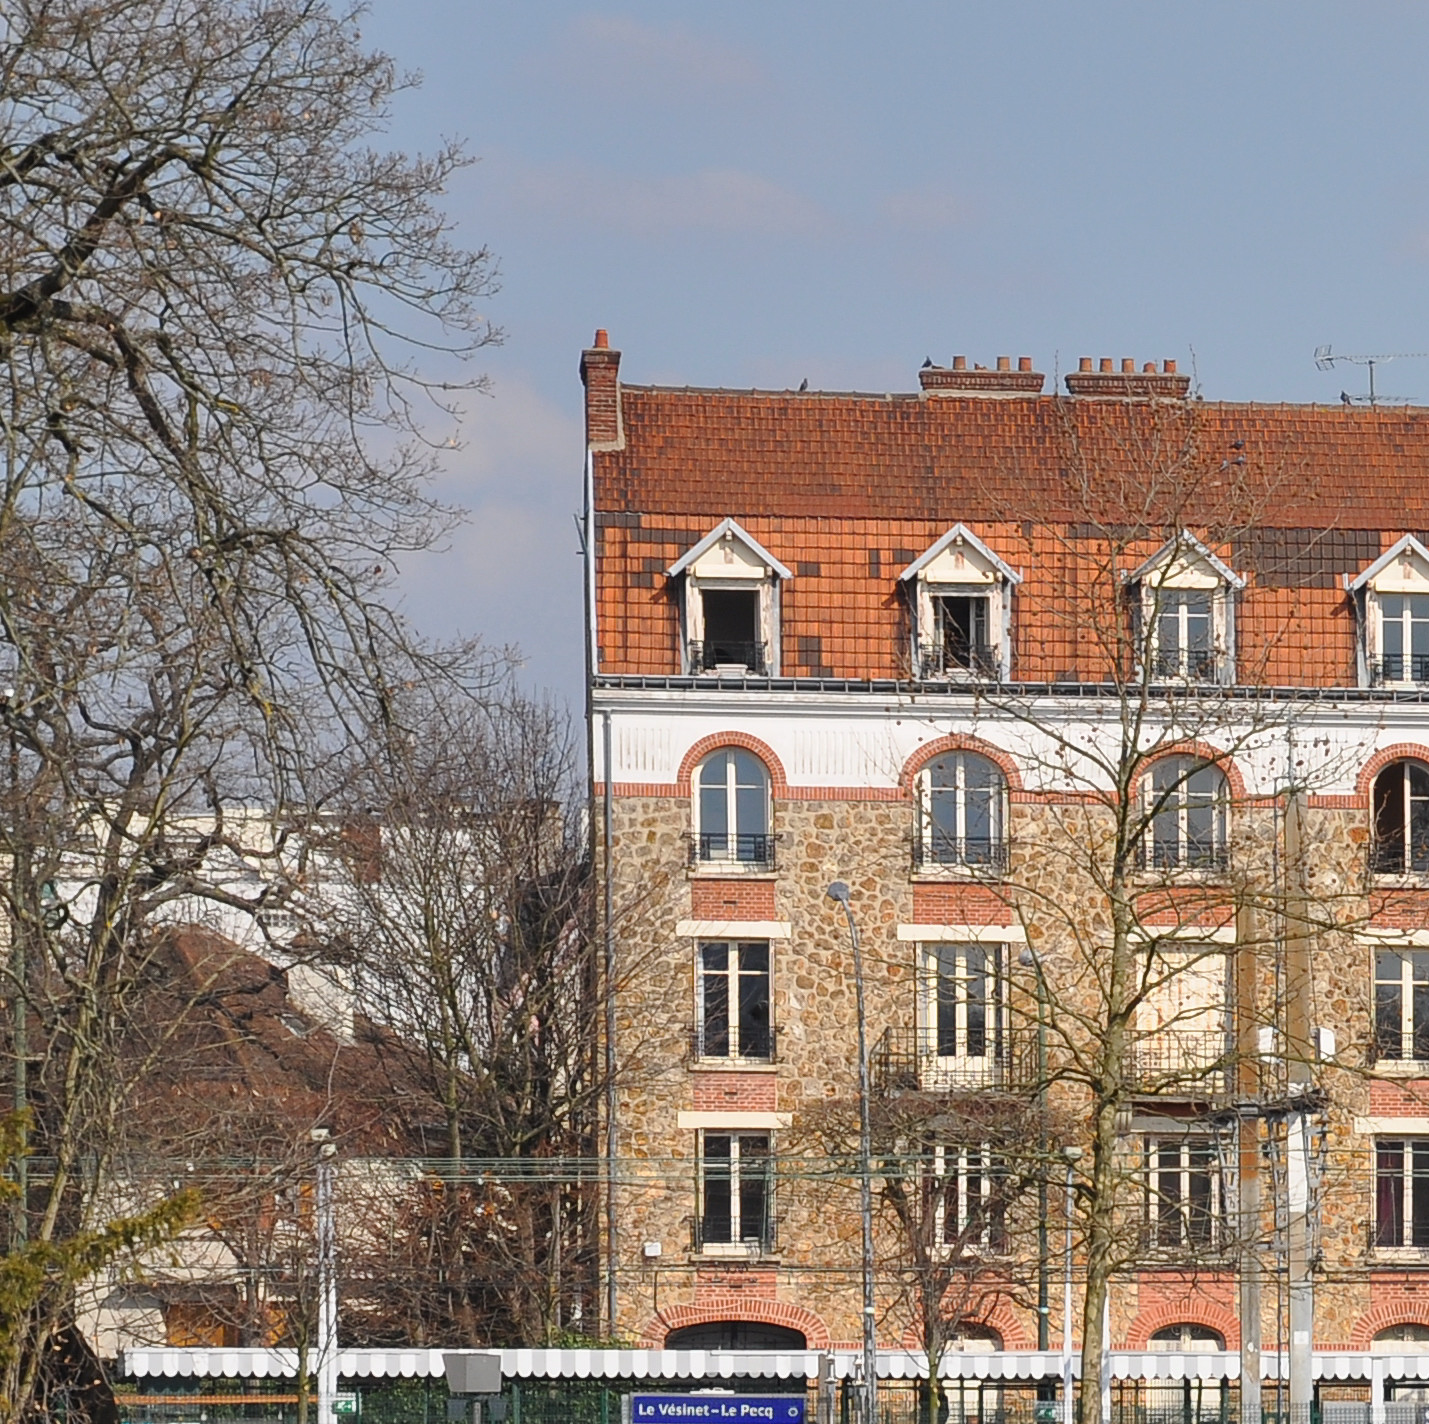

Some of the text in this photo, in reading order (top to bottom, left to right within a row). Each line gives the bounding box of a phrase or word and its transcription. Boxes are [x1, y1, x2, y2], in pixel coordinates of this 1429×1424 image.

[638, 1403, 655, 1416] Le
[658, 1403, 710, 1417] Vésinet
[721, 1404, 737, 1417] Le
[740, 1404, 773, 1420] Pecq
